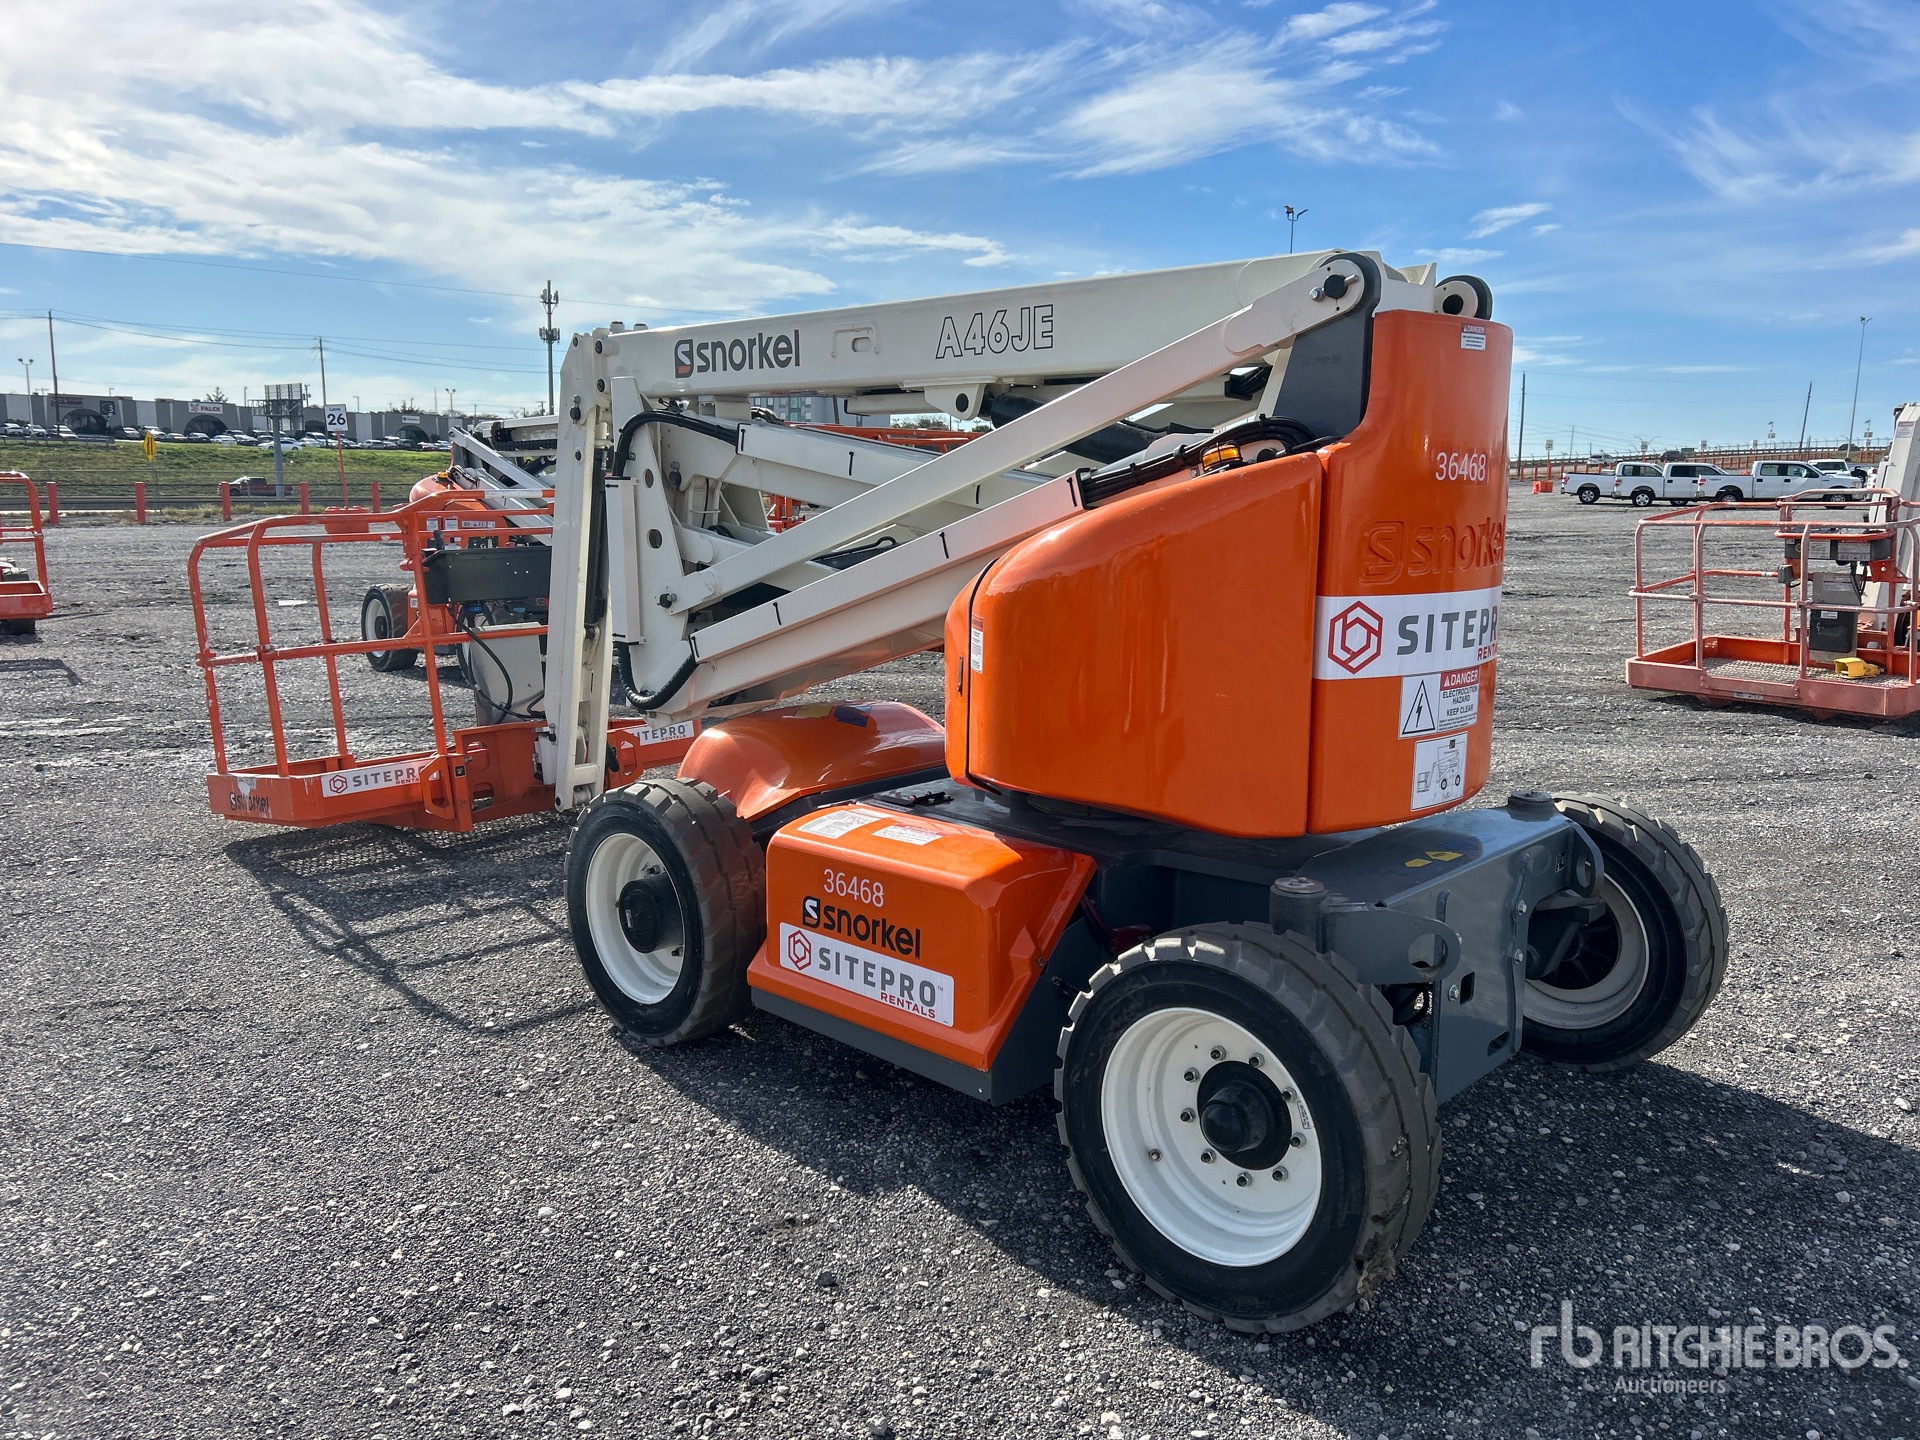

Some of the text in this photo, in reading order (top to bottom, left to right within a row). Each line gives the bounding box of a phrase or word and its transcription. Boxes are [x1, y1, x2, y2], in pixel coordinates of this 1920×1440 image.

[935, 304, 1054, 359] A46JE
[697, 329, 800, 373] snorkel
[327, 413, 346, 426] 26
[1435, 452, 1486, 481] 36468
[1397, 605, 1498, 656] SITEPR
[1450, 669, 1479, 686] DANGER
[1442, 685, 1478, 699] ELECTROCUTION
[1453, 694, 1471, 705] HAZARD
[1446, 704, 1474, 717] KEEP CLEAR
[632, 724, 686, 741] ITEPRO
[395, 777, 420, 785] RENTA
[823, 868, 885, 908] 36468
[823, 905, 921, 960] snorkel
[880, 992, 936, 1019] RENTALS
